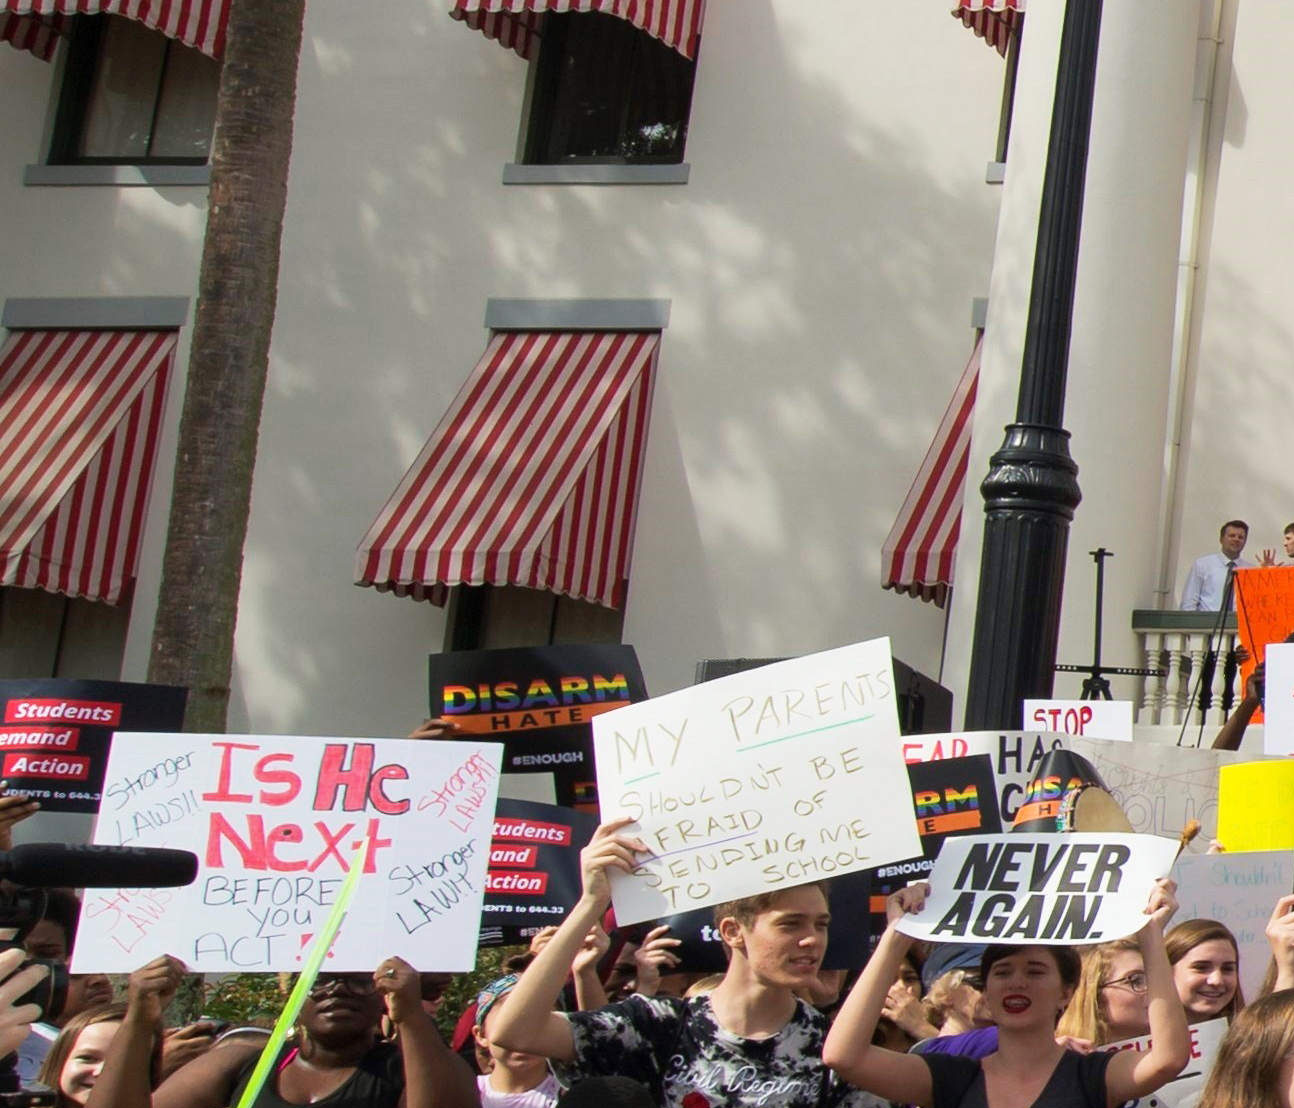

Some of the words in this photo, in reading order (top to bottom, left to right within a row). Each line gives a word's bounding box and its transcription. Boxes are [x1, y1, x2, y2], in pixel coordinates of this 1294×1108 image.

[15, 702, 113, 722] Students
[443, 673, 631, 715] DISARM
[491, 707, 583, 730] HATE
[613, 718, 689, 775] MY
[721, 668, 892, 742] PARENTS
[1034, 705, 1093, 736] STOP
[10, 757, 83, 775] Action
[202, 742, 302, 807] Is
[512, 751, 583, 766] #ENOUGH
[619, 763, 783, 823] SHOULDN'T
[810, 748, 864, 781] BE
[793, 790, 827, 817] OF
[205, 812, 392, 874] Next
[632, 831, 806, 888] SENDING
[819, 819, 871, 844] ME
[203, 875, 345, 906] BEFORE
[660, 882, 711, 909] TO
[761, 846, 871, 883] SCHOOL
[953, 842, 1131, 893] NEVER
[930, 891, 1104, 941] AGAIN.
[195, 932, 286, 967] ACT
[664, 1053, 721, 1090] Civil
[727, 1065, 821, 1106] Regime
